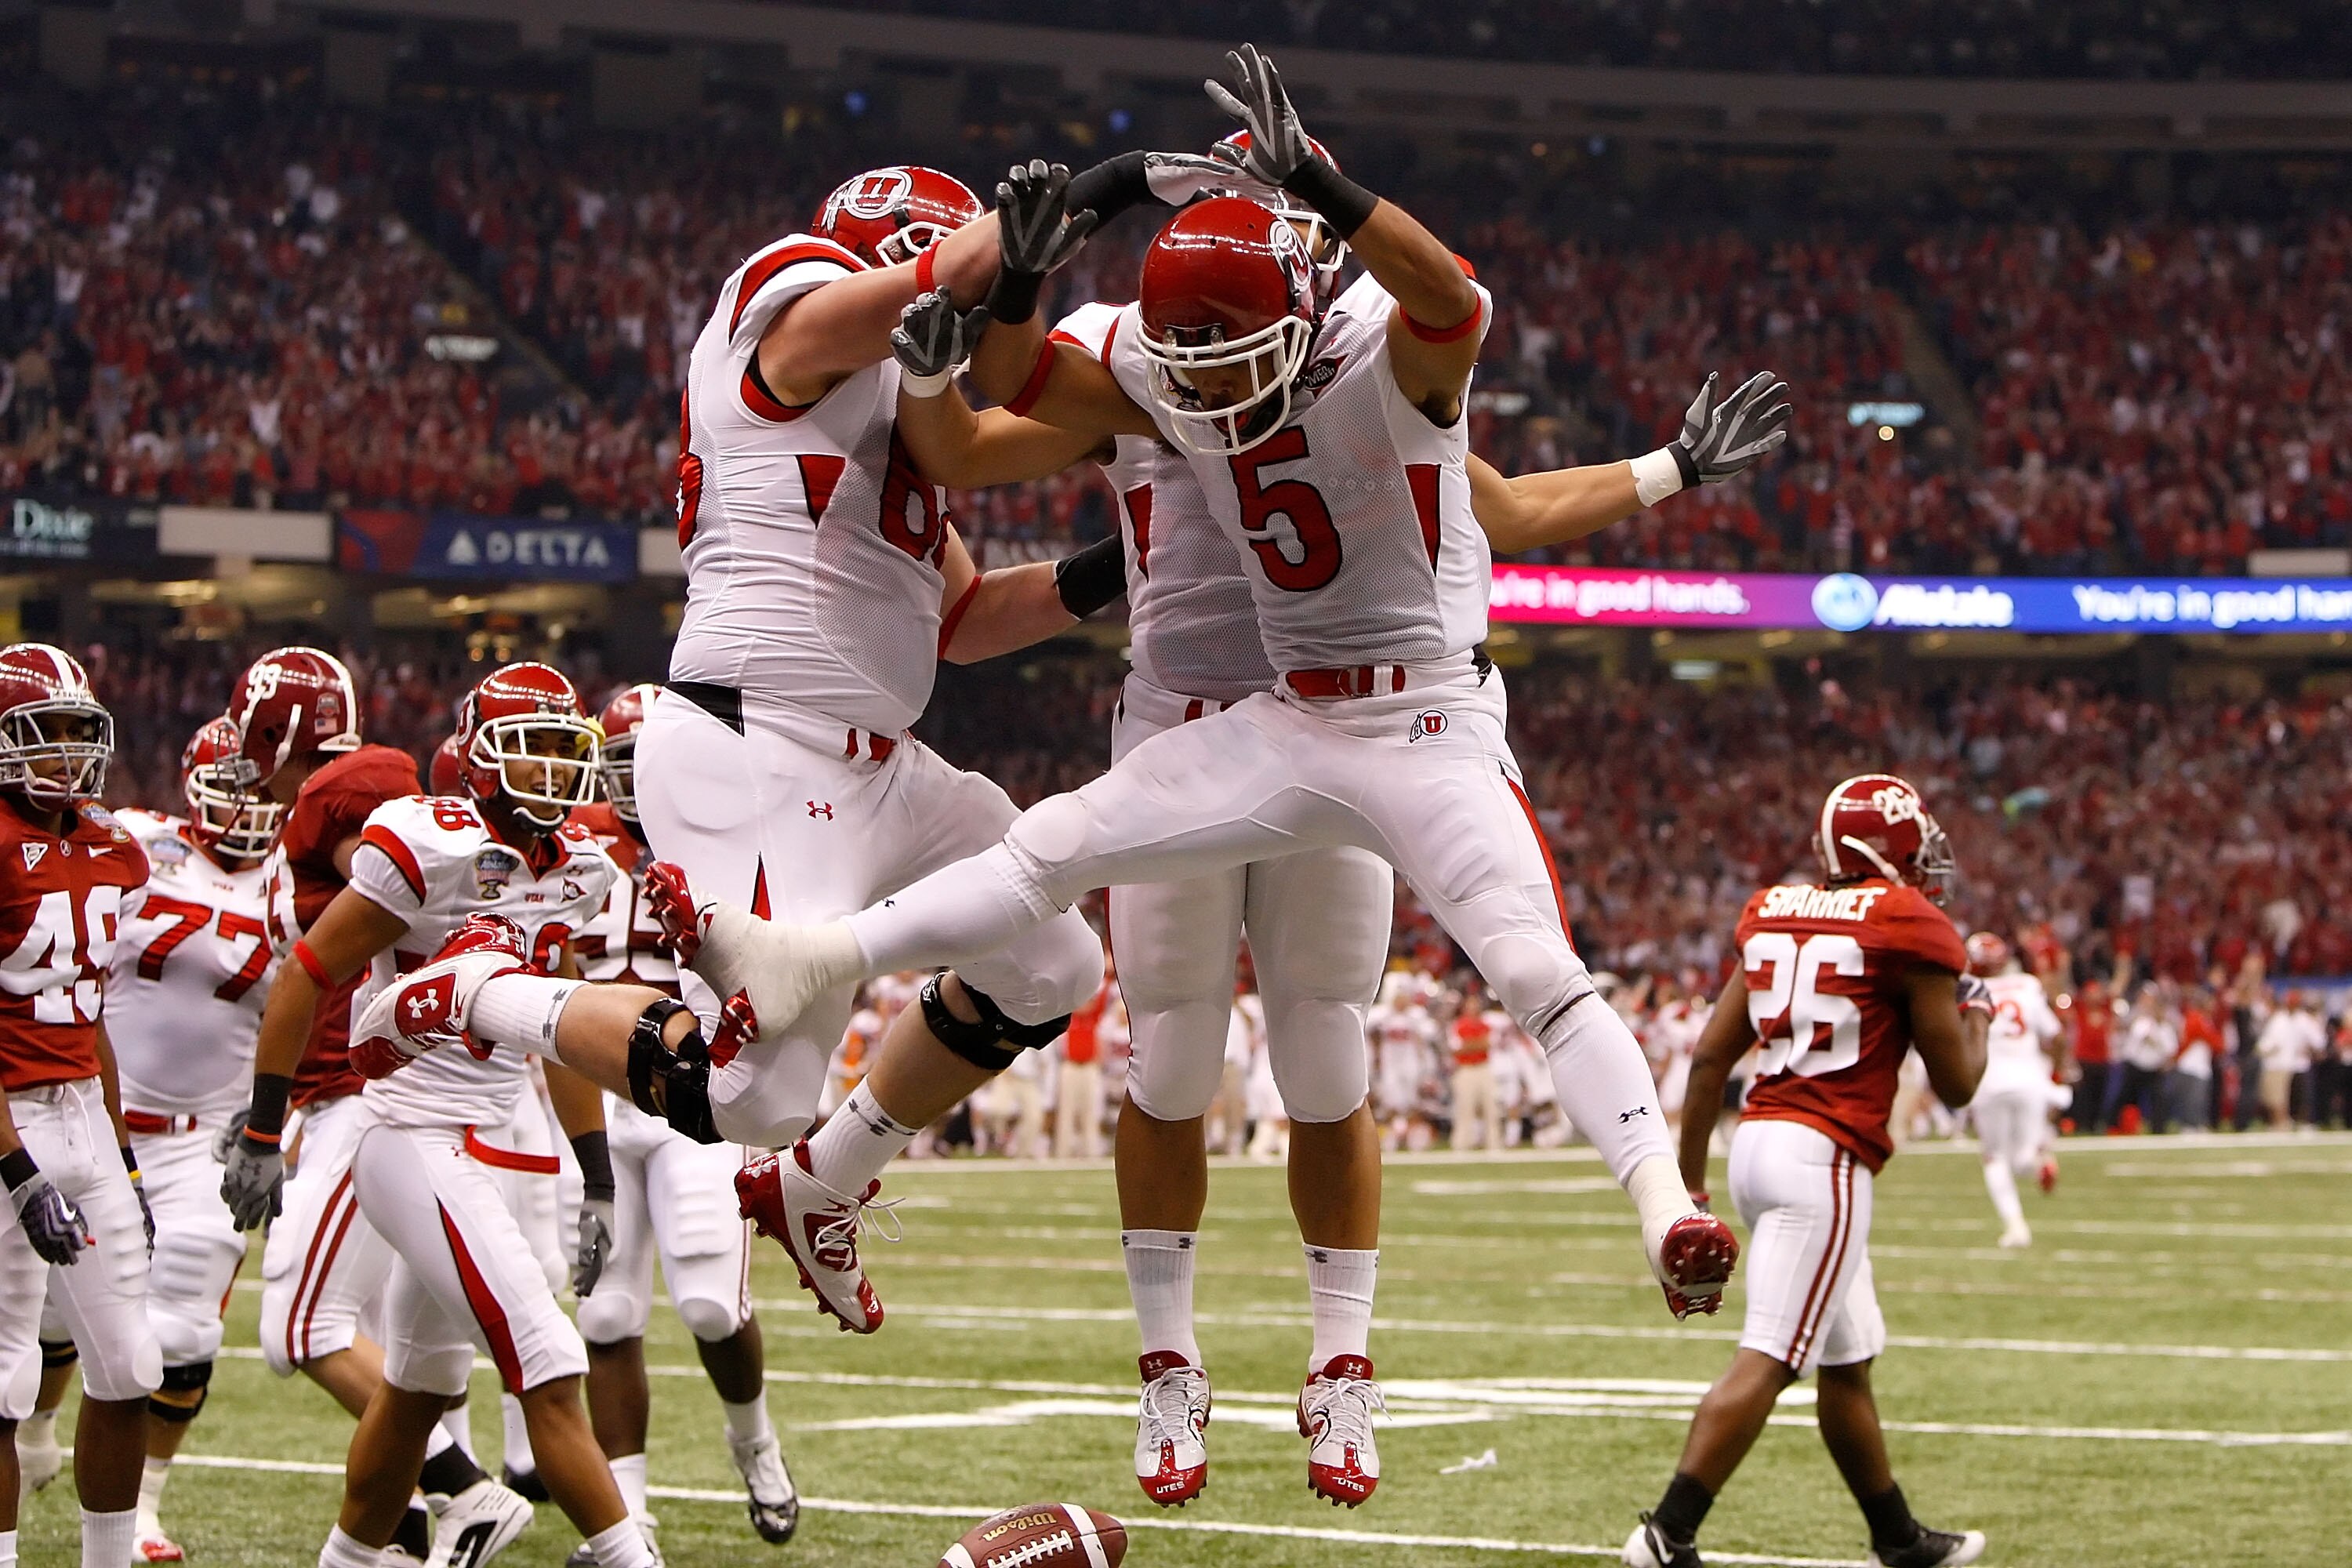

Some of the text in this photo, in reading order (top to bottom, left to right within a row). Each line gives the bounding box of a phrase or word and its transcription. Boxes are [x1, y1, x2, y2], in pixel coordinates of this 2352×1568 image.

[1225, 425, 1343, 592] 5
[486, 530, 611, 568] DELTA
[1545, 572, 1577, 609] in
[1576, 575, 1651, 618] good
[1651, 576, 1751, 615] hands.
[1872, 584, 2014, 627] Allstate
[2072, 585, 2352, 629] You're in good han
[245, 663, 283, 700] 93
[1423, 716, 1442, 733] U
[1872, 786, 1918, 826] 26
[525, 893, 546, 902] UTAH
[137, 895, 274, 1004] 77
[1743, 932, 1865, 1078] 26
[1156, 1480, 1185, 1494] UTES
[1338, 1477, 1365, 1493] UTES
[982, 1512, 1058, 1542] Wilson
